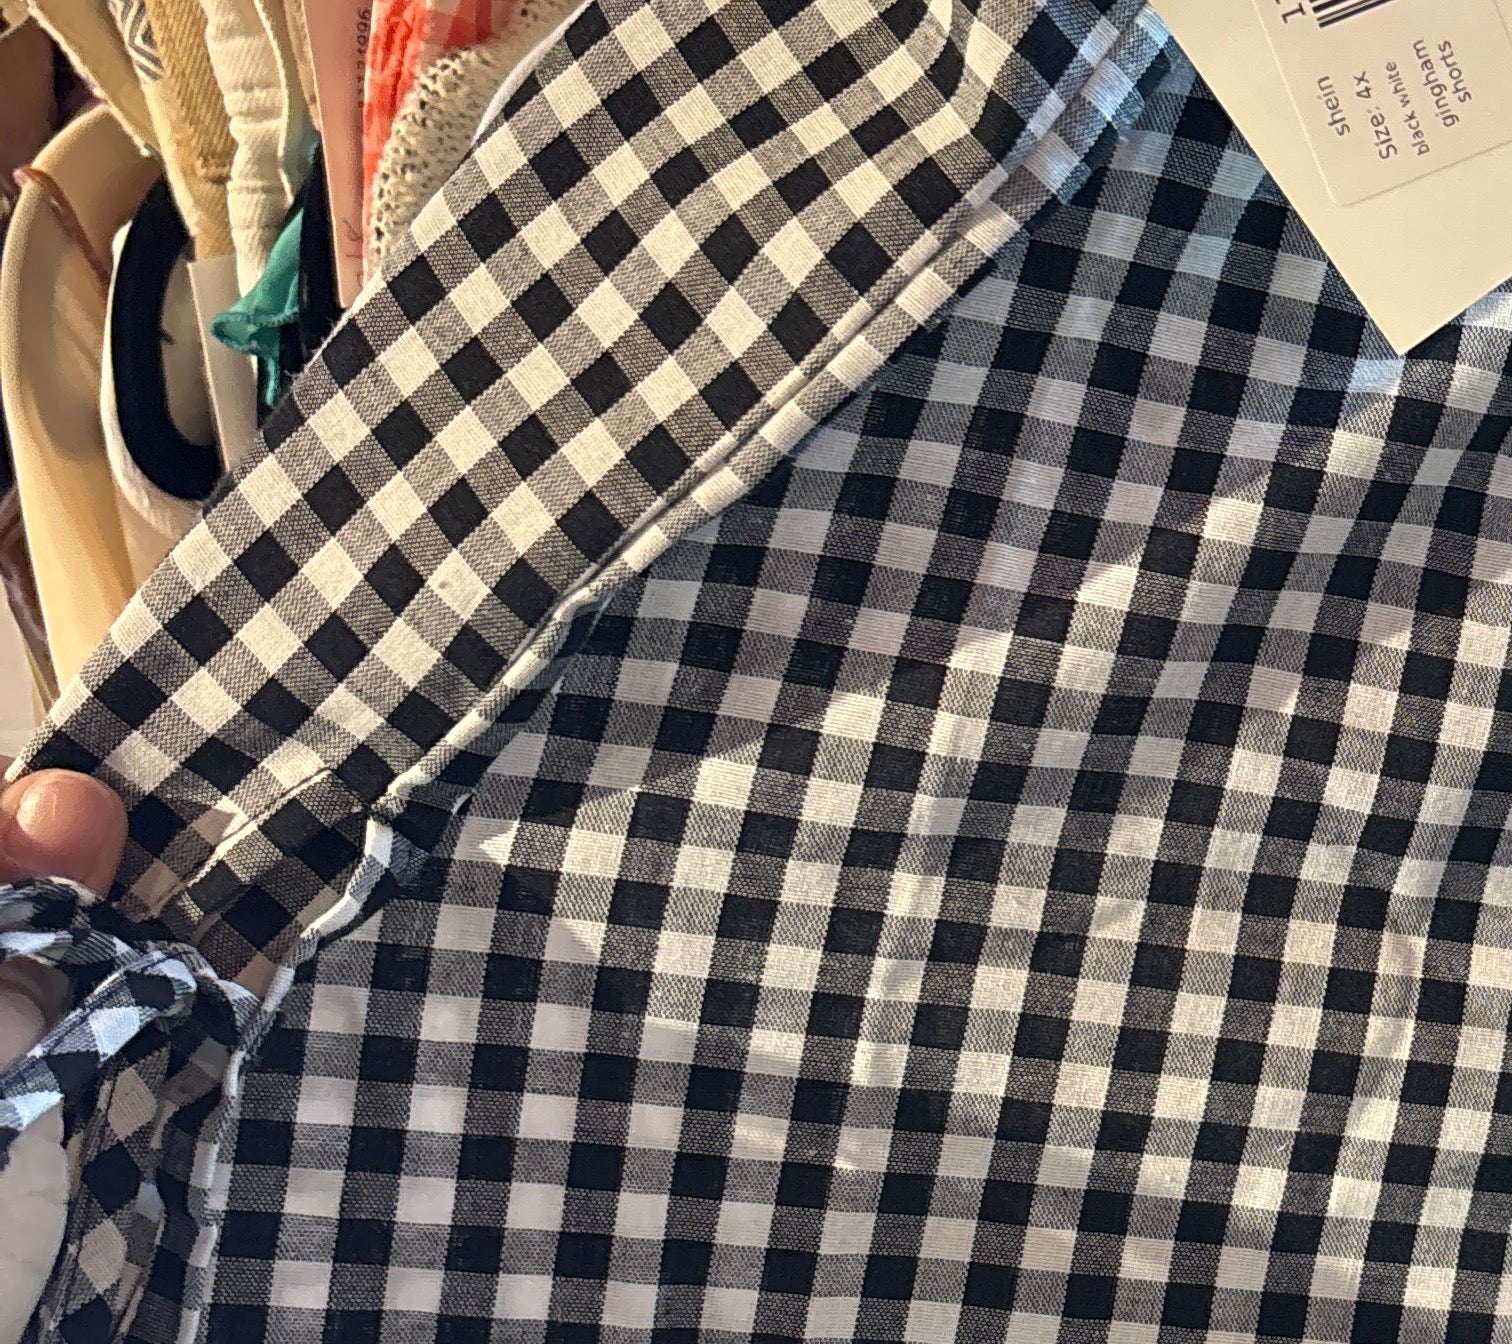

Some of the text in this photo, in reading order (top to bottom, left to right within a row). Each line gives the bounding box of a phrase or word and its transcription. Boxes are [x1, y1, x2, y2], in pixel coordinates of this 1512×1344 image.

[1316, 75, 1351, 137] shein
[1353, 70, 1398, 160] Size: 4x
[1385, 61, 1431, 156] black white
[1412, 39, 1460, 128] gingham
[1437, 39, 1473, 104] shorts
